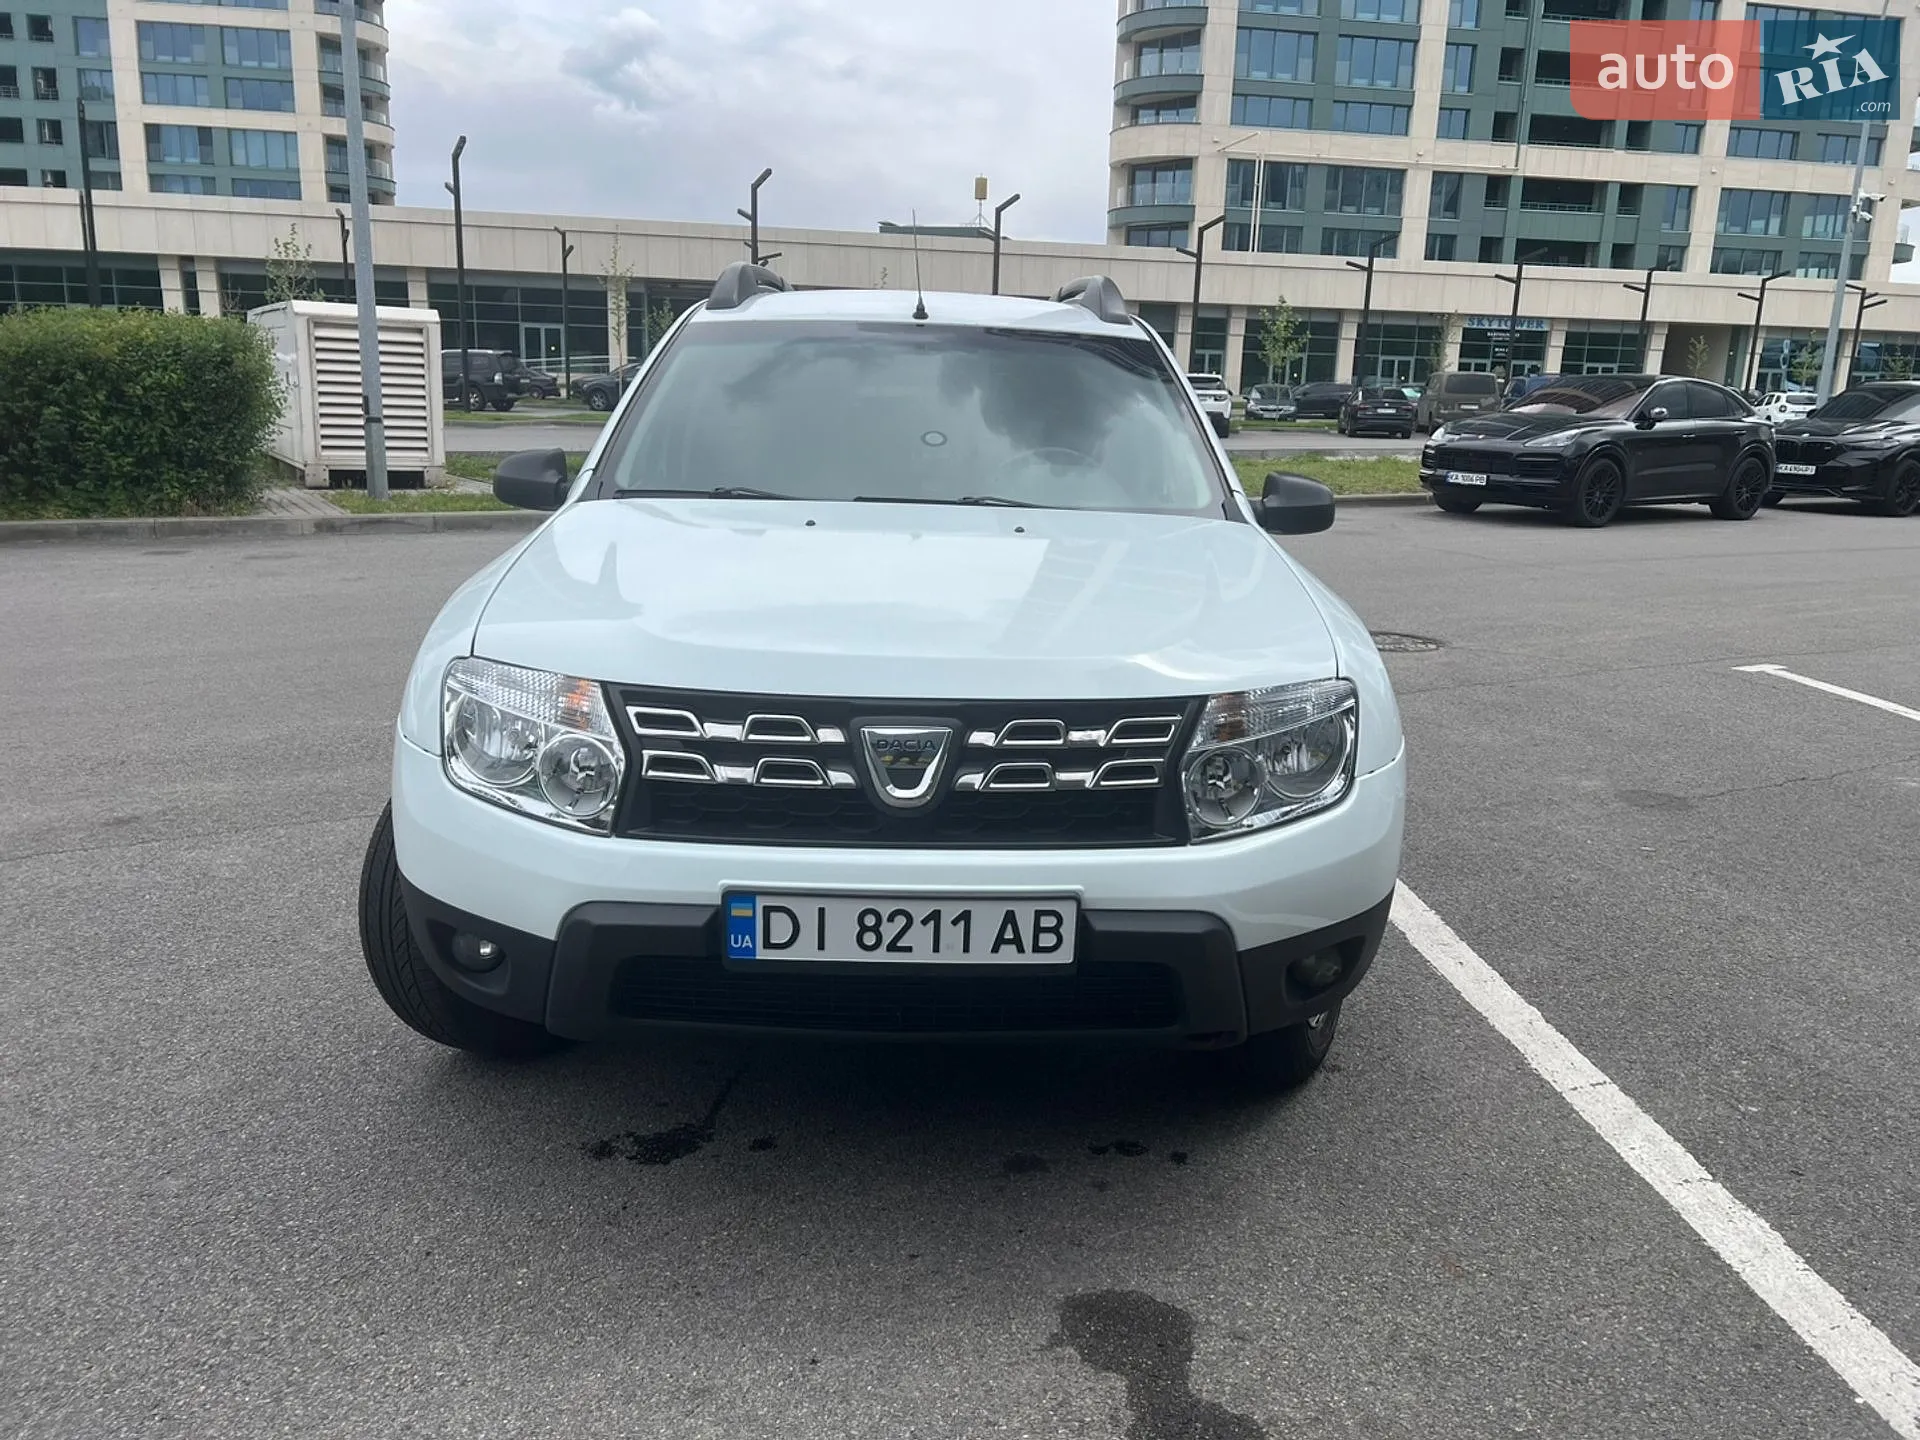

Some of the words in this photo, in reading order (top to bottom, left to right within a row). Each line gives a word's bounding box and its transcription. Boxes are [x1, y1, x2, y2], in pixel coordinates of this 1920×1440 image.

[1467, 317, 1545, 329] SKYTOWER
[876, 740, 936, 751] DACIA
[762, 905, 826, 951] DI
[855, 907, 972, 953] 8211
[990, 909, 1064, 953] AB
[730, 934, 753, 948] UA
